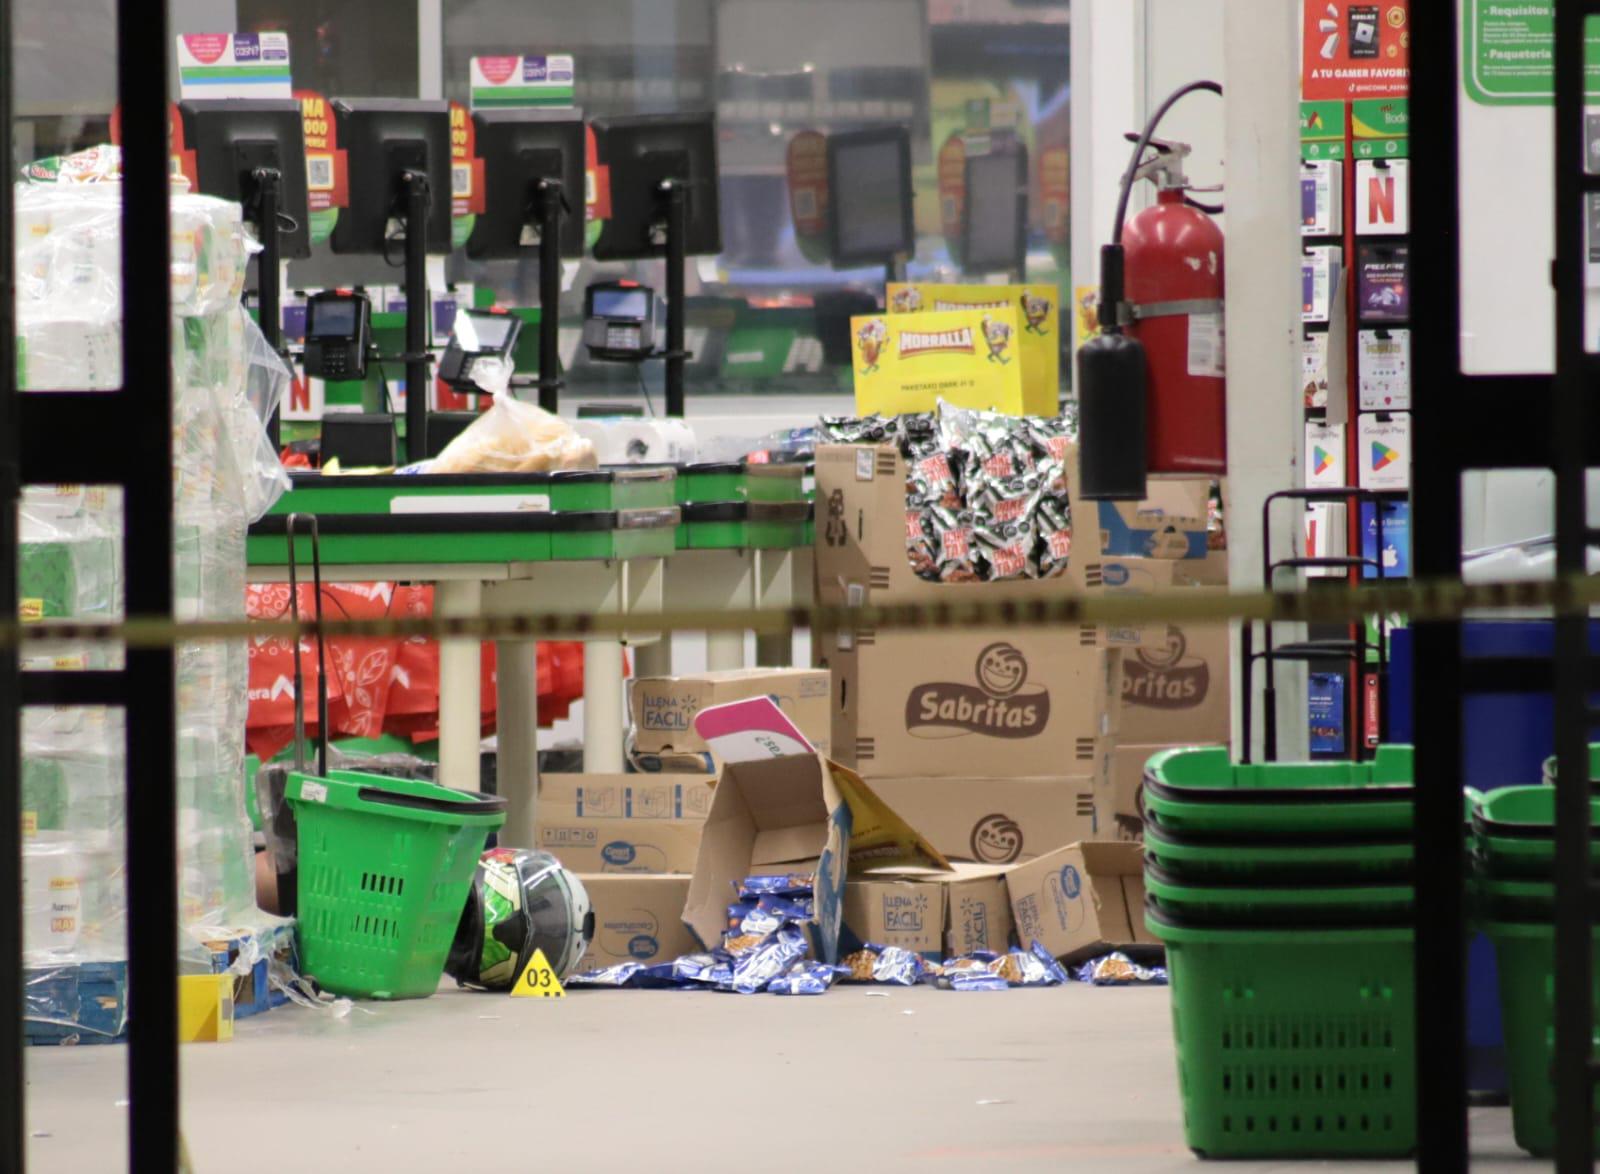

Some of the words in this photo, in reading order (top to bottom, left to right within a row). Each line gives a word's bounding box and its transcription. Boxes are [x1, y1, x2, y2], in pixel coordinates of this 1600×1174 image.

[1489, 5, 1549, 18] Requisitos
[1312, 69, 1319, 78] A
[1320, 69, 1333, 78] TU
[1334, 69, 1369, 78] GAMER
[1369, 177, 1394, 224] N
[901, 327, 972, 352] MORRALLA
[646, 696, 678, 706] LLENA
[919, 691, 1037, 728] Sabritas
[887, 896, 912, 907] LLENA
[527, 969, 551, 987] 03
